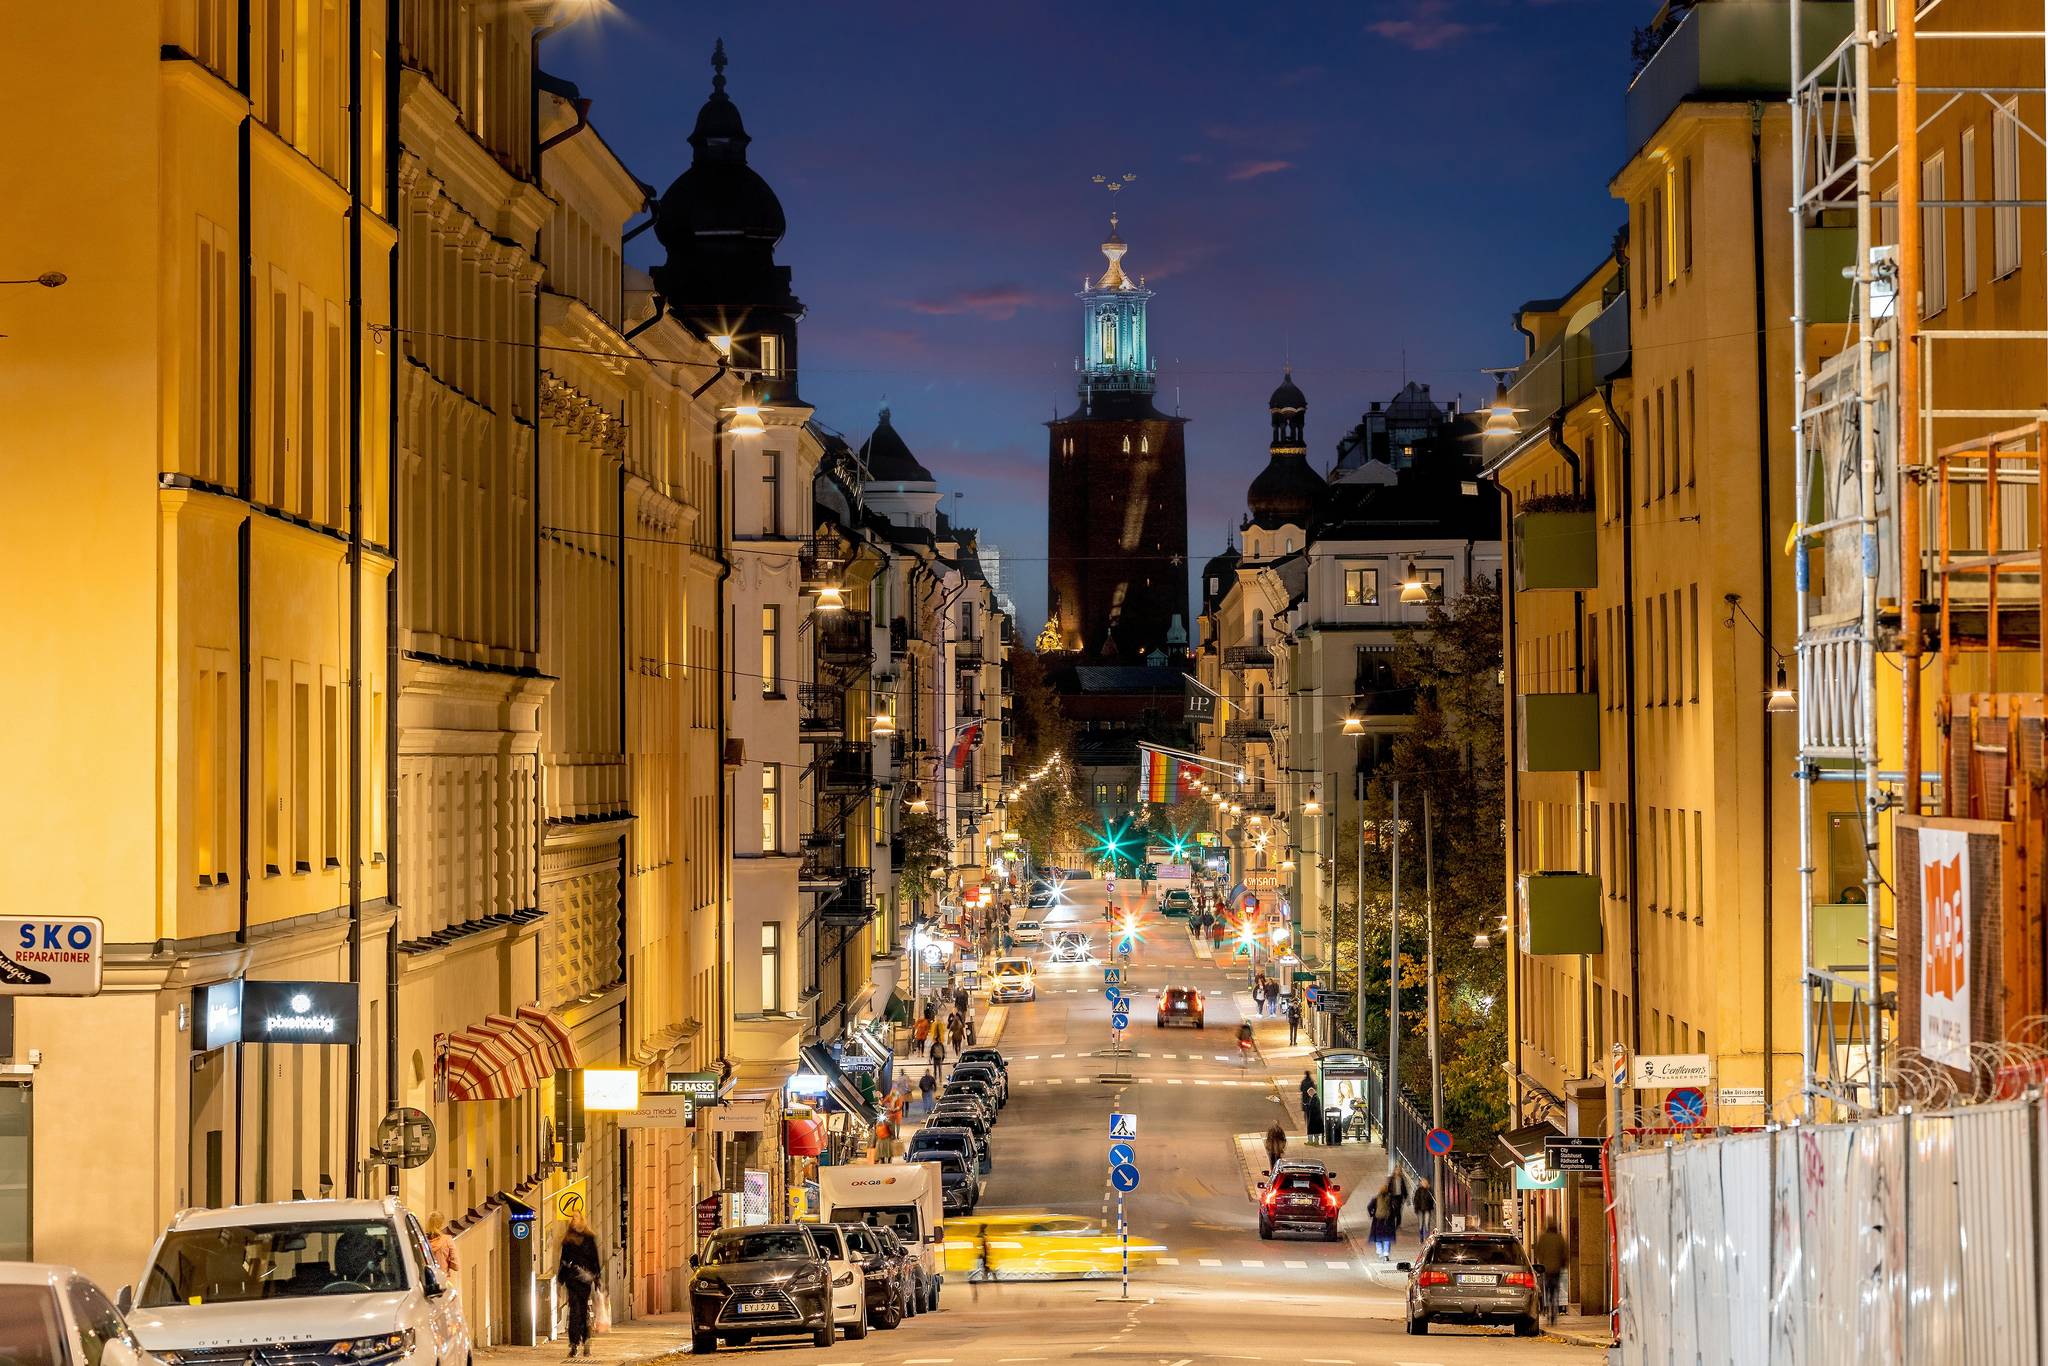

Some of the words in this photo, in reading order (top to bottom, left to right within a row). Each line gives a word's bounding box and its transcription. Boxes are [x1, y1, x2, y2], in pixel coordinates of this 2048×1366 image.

[19, 923, 92, 950] SKO
[15, 950, 91, 963] REPARATIONER
[671, 1083, 682, 1092] DE
[684, 1083, 715, 1092] BASSO
[517, 1225, 526, 1236] P
[744, 1304, 759, 1313] EYJ
[760, 1303, 776, 1311] 276
